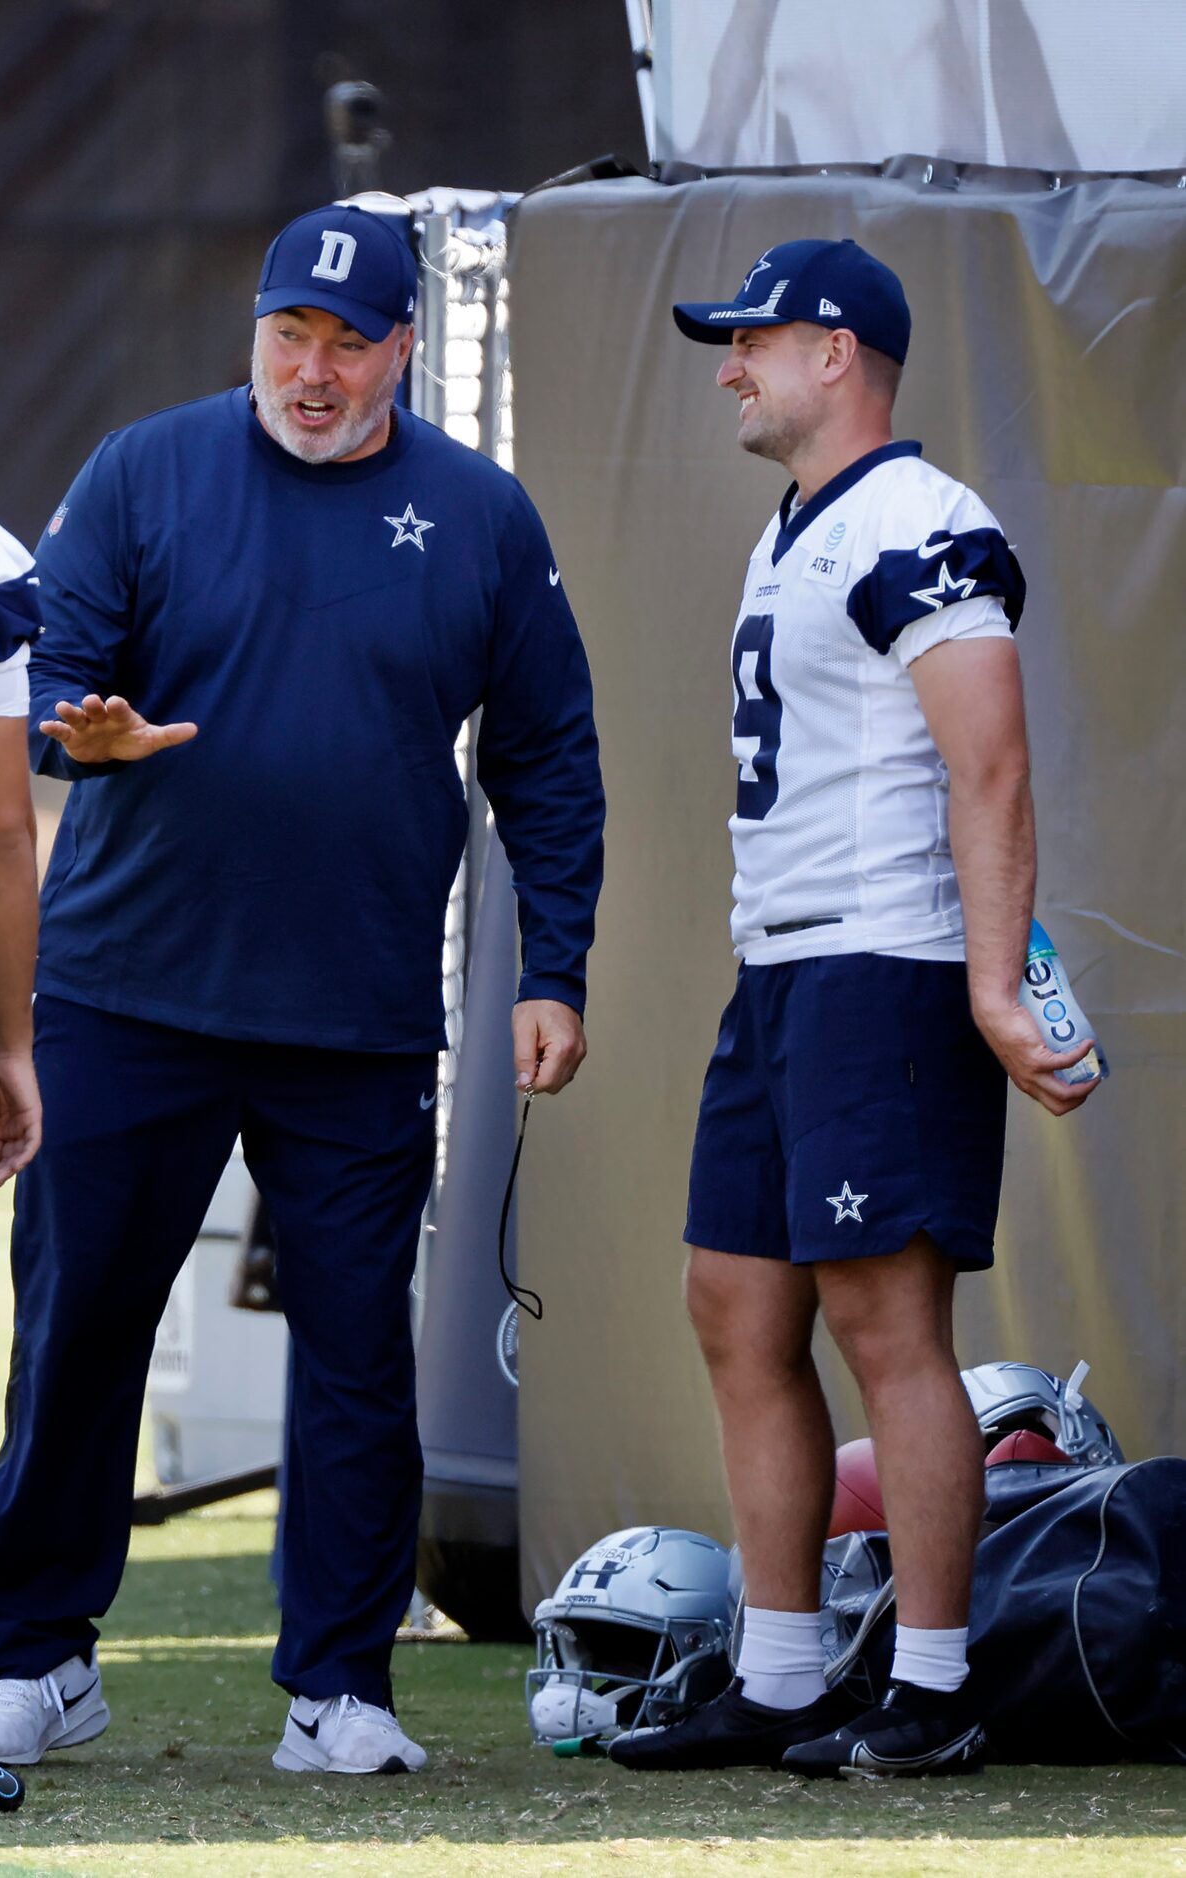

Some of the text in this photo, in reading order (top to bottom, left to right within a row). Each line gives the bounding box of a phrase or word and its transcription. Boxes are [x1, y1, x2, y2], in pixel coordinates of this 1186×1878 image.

[311, 230, 357, 283] D
[810, 556, 836, 575] AT&T
[732, 613, 783, 821] 9
[1024, 961, 1075, 1042] core
